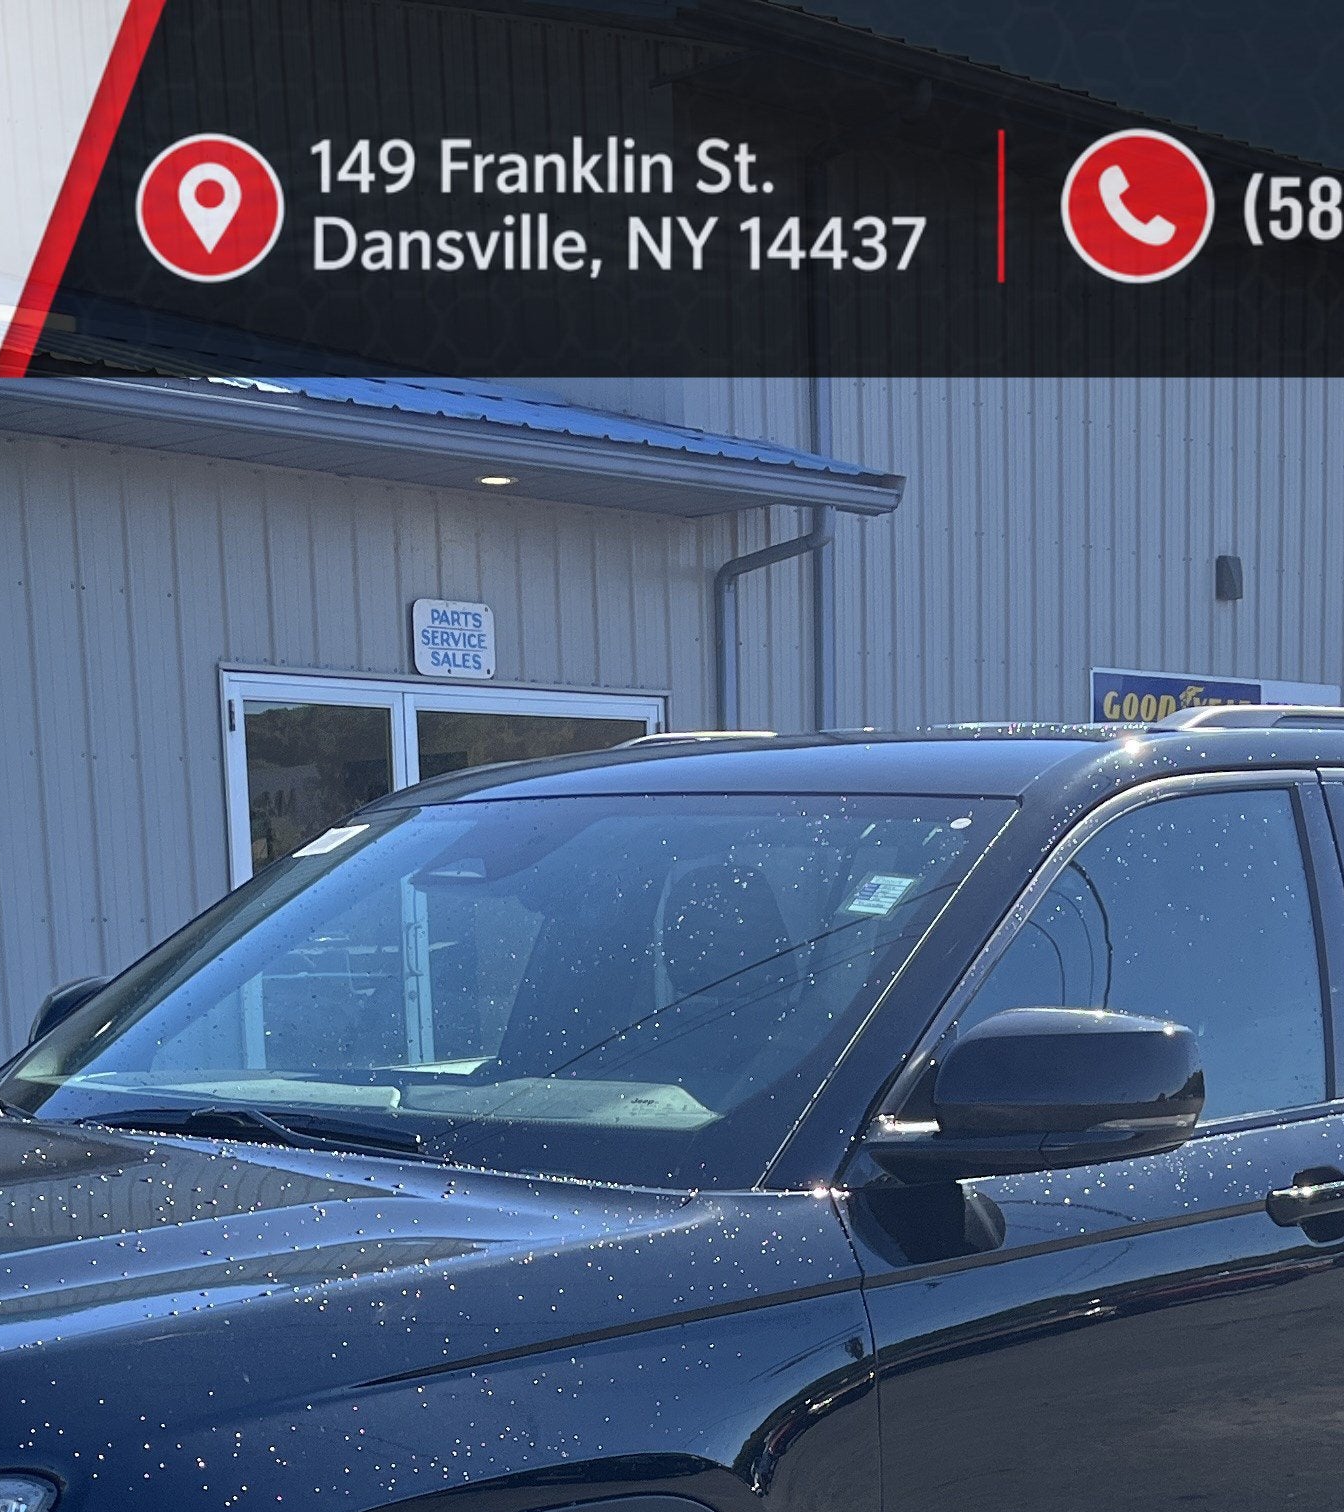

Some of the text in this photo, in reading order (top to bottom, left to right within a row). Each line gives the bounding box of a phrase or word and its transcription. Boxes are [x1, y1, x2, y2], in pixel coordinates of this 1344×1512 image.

[431, 608, 482, 628] PARTS
[421, 629, 487, 649] SERVICE
[431, 650, 482, 670] SALES
